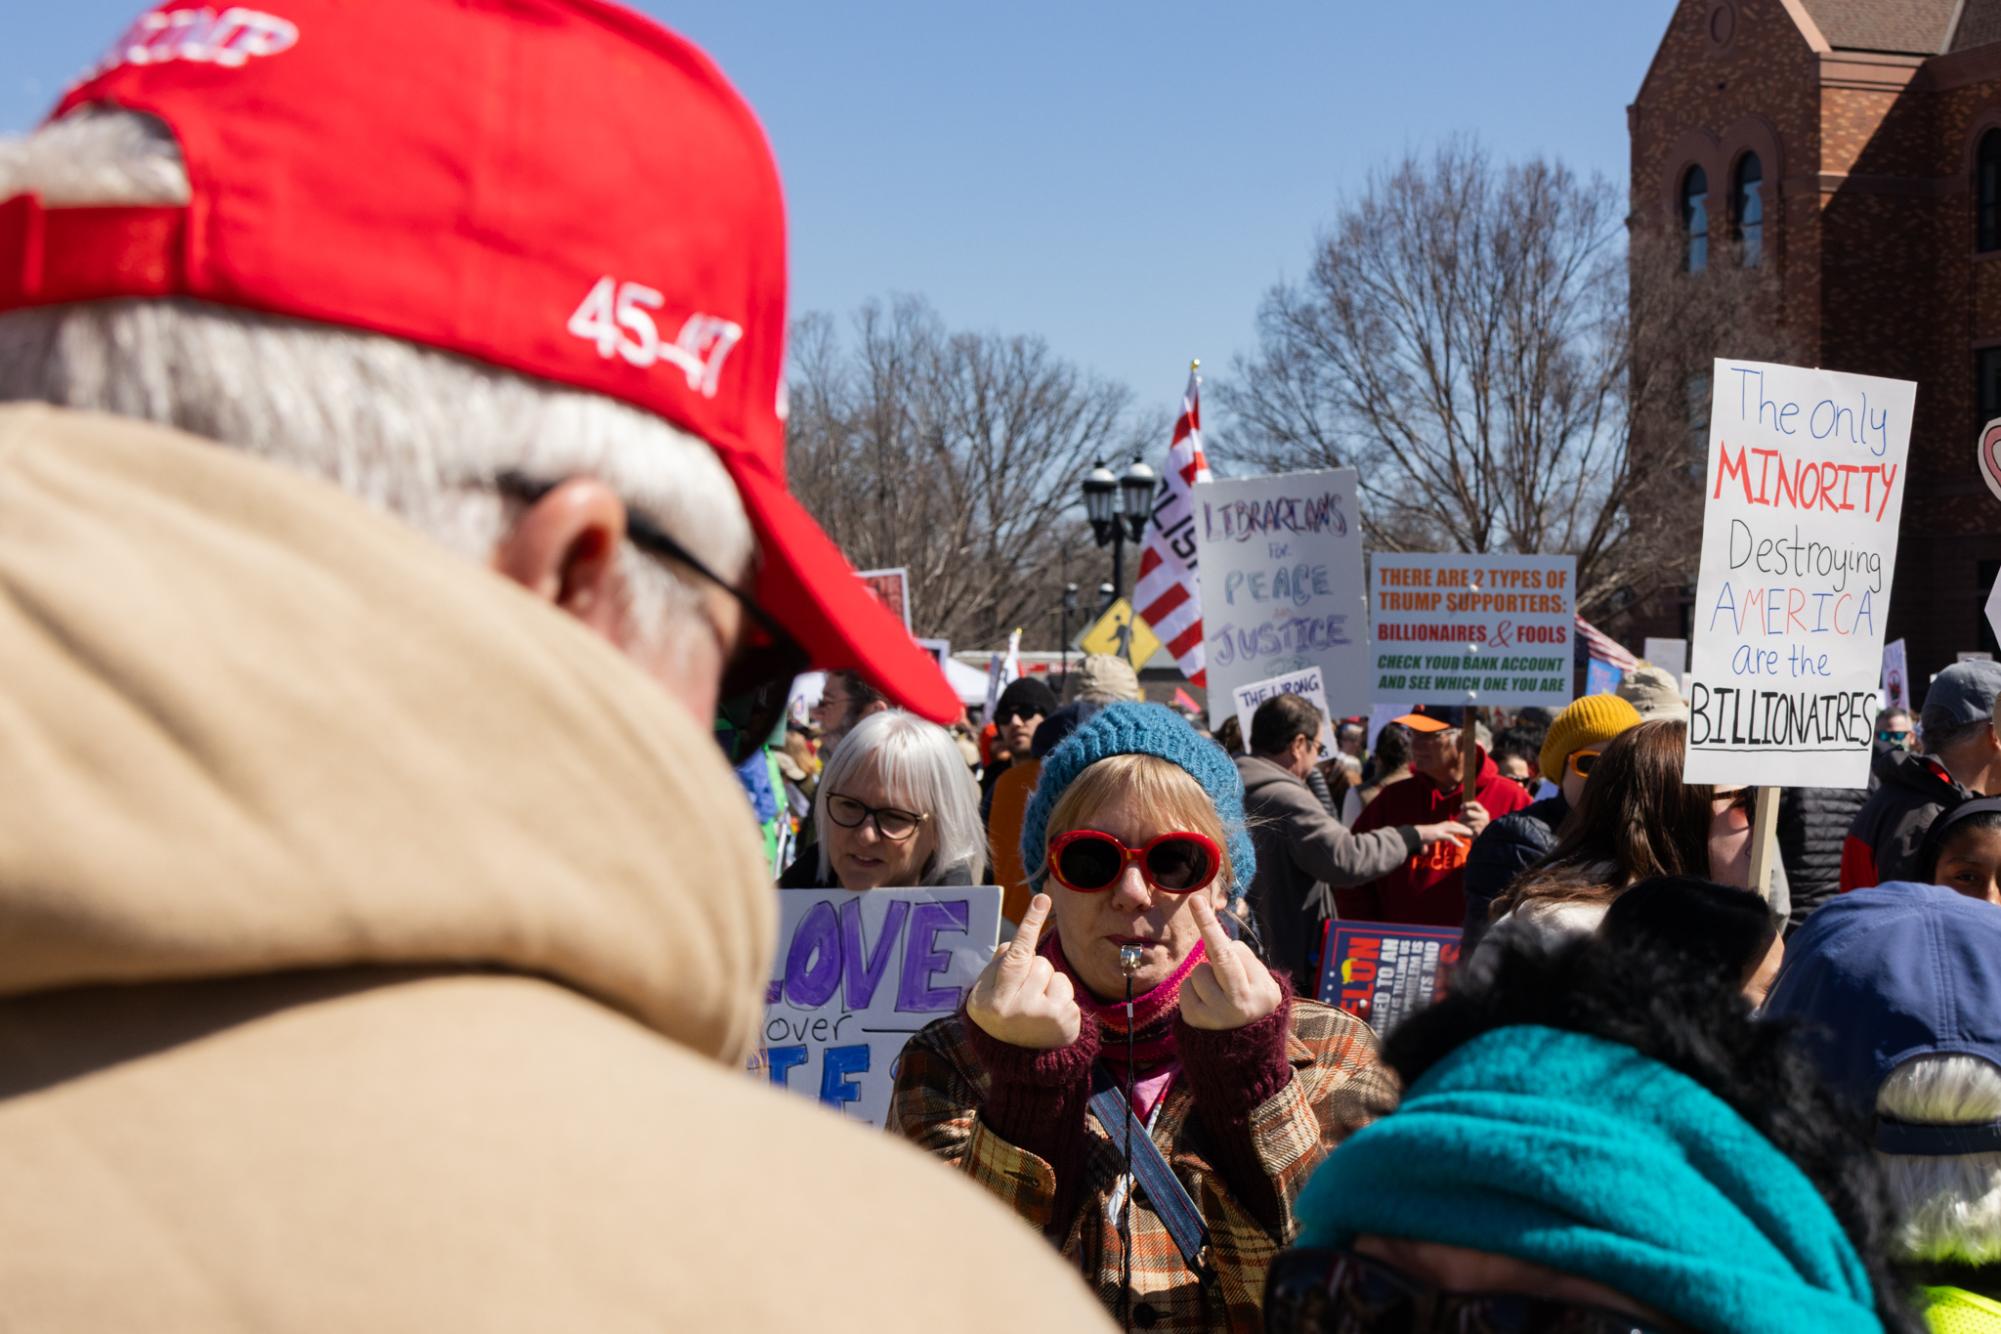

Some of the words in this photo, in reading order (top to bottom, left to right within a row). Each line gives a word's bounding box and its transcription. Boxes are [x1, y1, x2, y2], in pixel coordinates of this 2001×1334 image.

[567, 275, 743, 399] 45-47
[1731, 368, 1800, 435] The
[1713, 440, 1898, 522] MINORITY
[1730, 519, 1882, 593] Destroying
[1225, 563, 1333, 606] PEACE
[1379, 568, 1432, 587] THERE
[1436, 569, 1469, 587] ARE
[1473, 569, 1484, 588] 2
[1488, 569, 1542, 589] TYPES
[1546, 570, 1567, 590] OF
[1379, 592, 1441, 611] TRUMP
[1446, 593, 1567, 613] SUPPORTERS:
[1709, 581, 1874, 636] AMERICA
[1211, 614, 1352, 666] JUSTICE
[1378, 623, 1487, 642] BILLIONAIRES
[1488, 620, 1513, 648] &
[1517, 626, 1566, 644] FOOLS
[1377, 655, 1422, 670] CHECK
[1425, 656, 1460, 671] YOUR
[1462, 656, 1498, 671] BANK
[1501, 657, 1565, 672] ACCOUNT
[1731, 644, 1778, 675] are
[1788, 644, 1832, 678] the
[1378, 675, 1406, 689] AND
[1408, 675, 1432, 690] SEE
[1434, 676, 1480, 690] WHICH
[1483, 677, 1508, 691] ONE
[1511, 678, 1539, 692] YOU
[1540, 678, 1565, 692] ARE
[1690, 682, 1877, 746] BILLIONAIRES
[766, 896, 969, 1013] OVE
[1380, 938, 1399, 963] AN
[1422, 941, 1440, 972] AND
[1341, 937, 1380, 1015] ELON
[1376, 966, 1395, 987] TO
[766, 1015, 853, 1042] over
